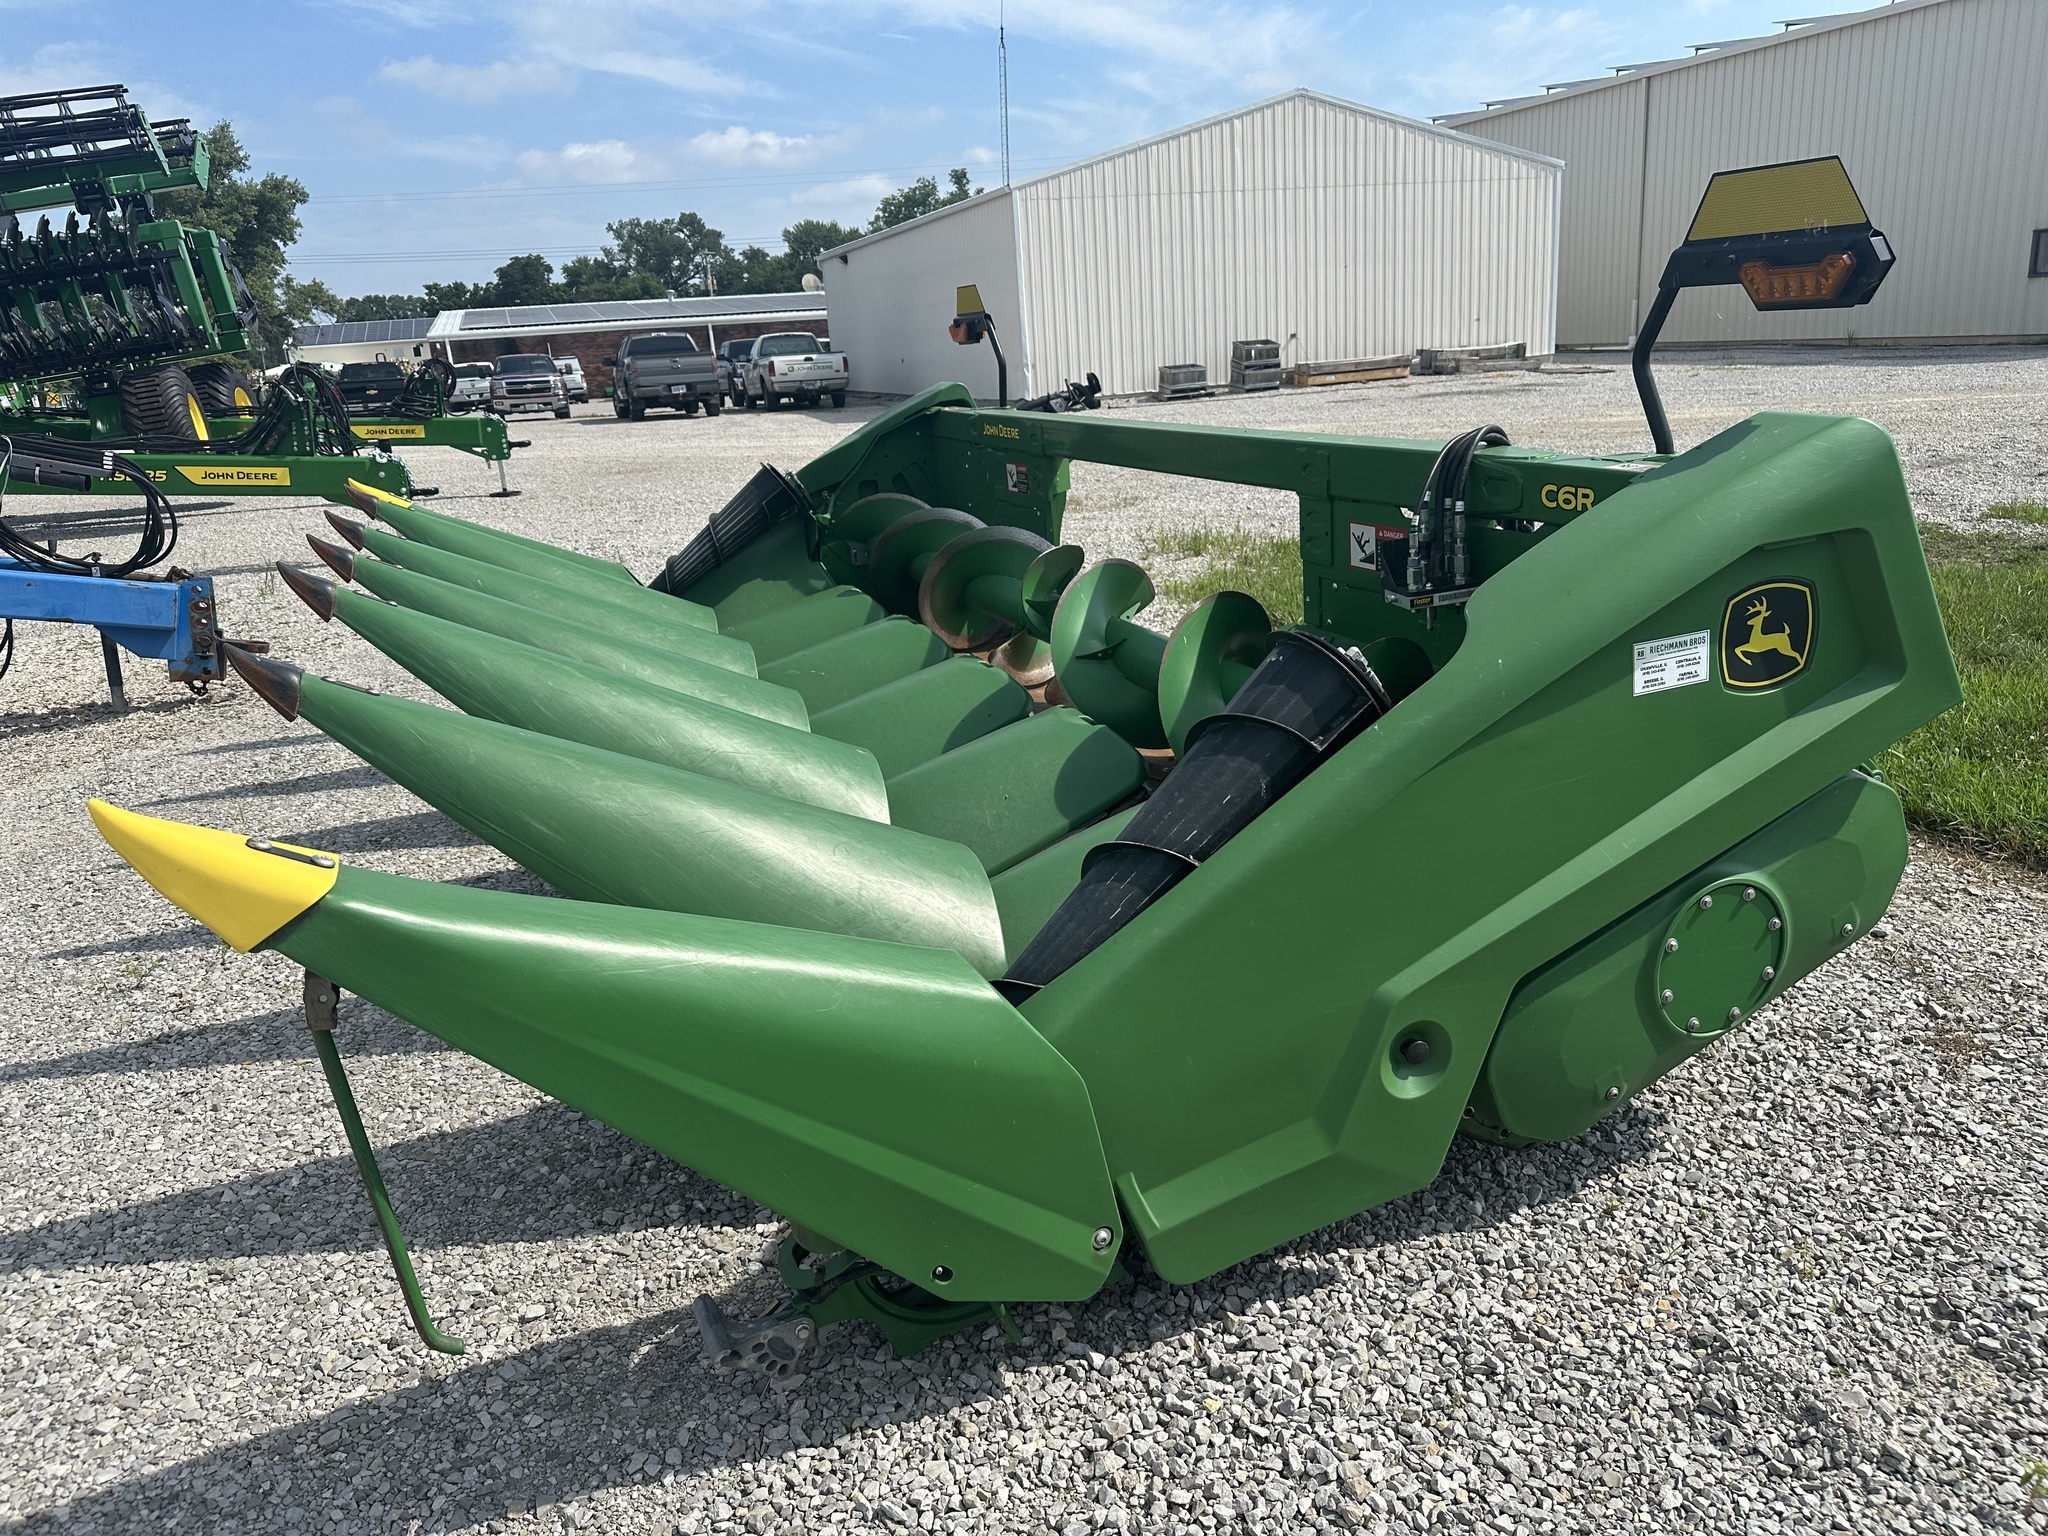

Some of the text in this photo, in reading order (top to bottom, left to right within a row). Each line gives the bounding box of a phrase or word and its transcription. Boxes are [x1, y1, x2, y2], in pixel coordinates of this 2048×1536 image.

[984, 422, 1020, 439] JOHN DEERE
[201, 470, 278, 480] JOHN DEERE
[1540, 484, 1595, 512] C6R
[1384, 530, 1404, 539] DANGER
[1650, 640, 1688, 654] RIECHMANN
[1690, 636, 1706, 646] BROS
